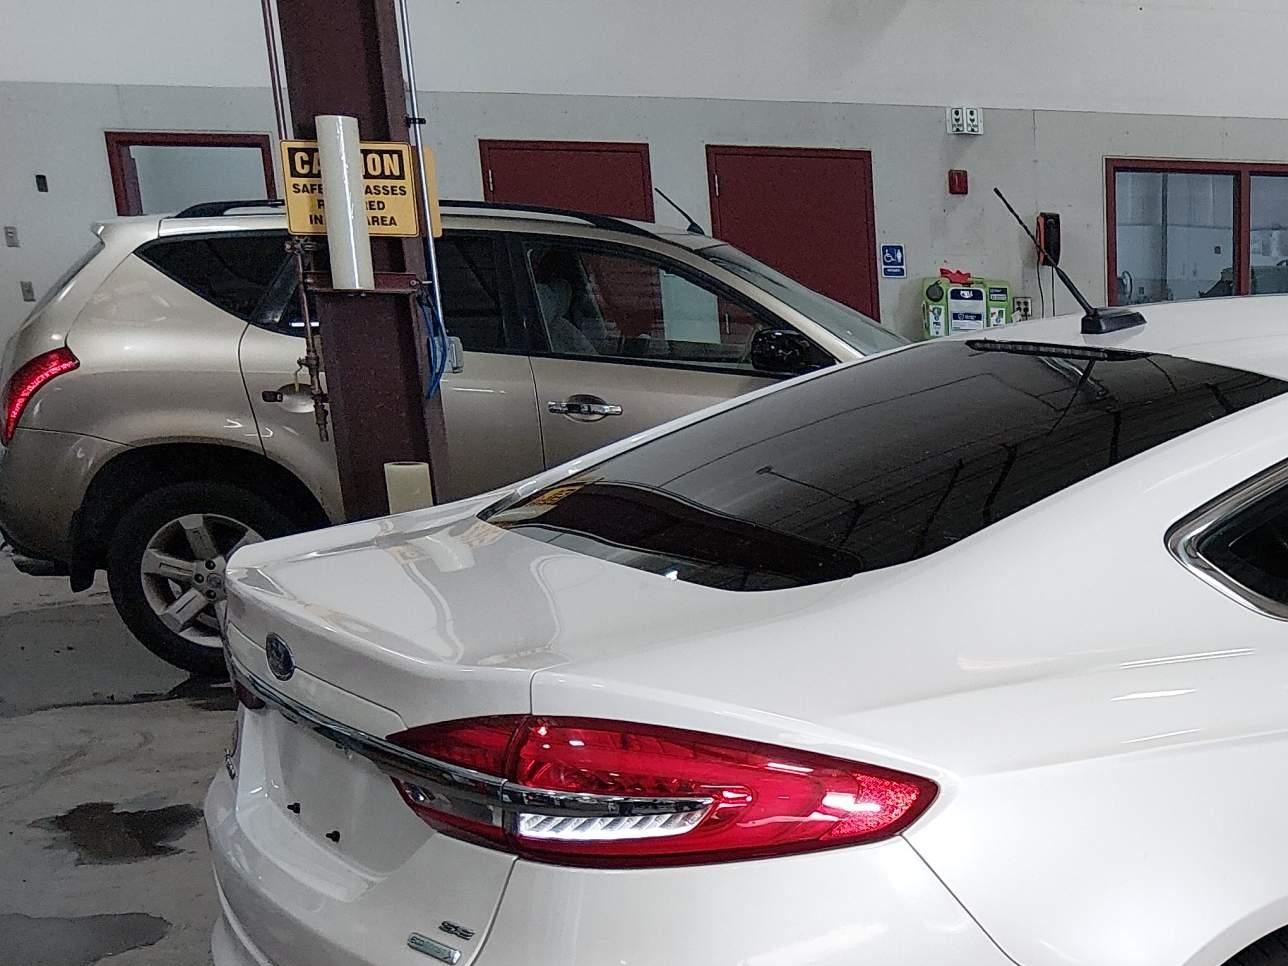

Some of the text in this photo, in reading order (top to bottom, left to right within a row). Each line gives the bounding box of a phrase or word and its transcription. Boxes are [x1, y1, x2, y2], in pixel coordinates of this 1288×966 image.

[292, 183, 407, 196] SAFE ASSES
[309, 214, 323, 225] IN
